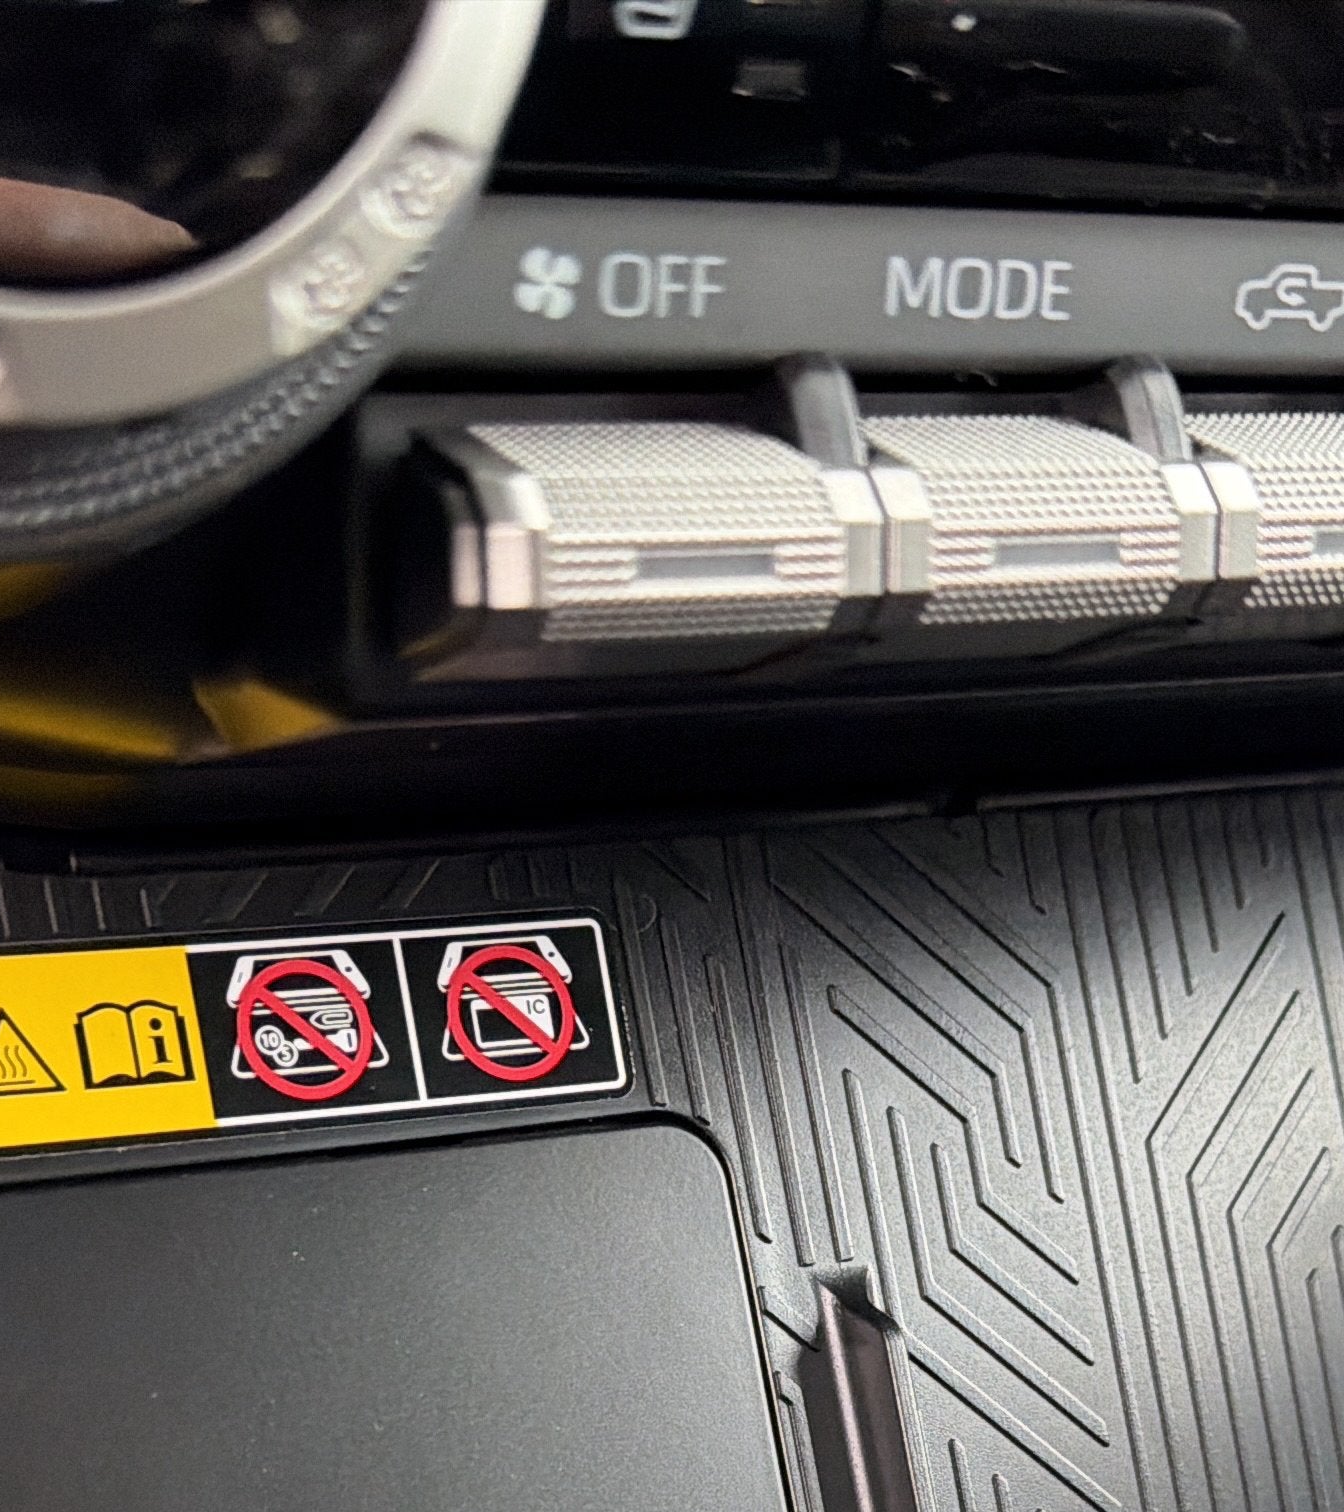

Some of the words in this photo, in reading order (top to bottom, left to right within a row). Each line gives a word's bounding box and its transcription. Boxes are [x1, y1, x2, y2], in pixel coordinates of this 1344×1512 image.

[598, 253, 727, 319] OFF
[884, 257, 1074, 322] MODE
[526, 999, 546, 1015] IC
[260, 1032, 279, 1050] 10
